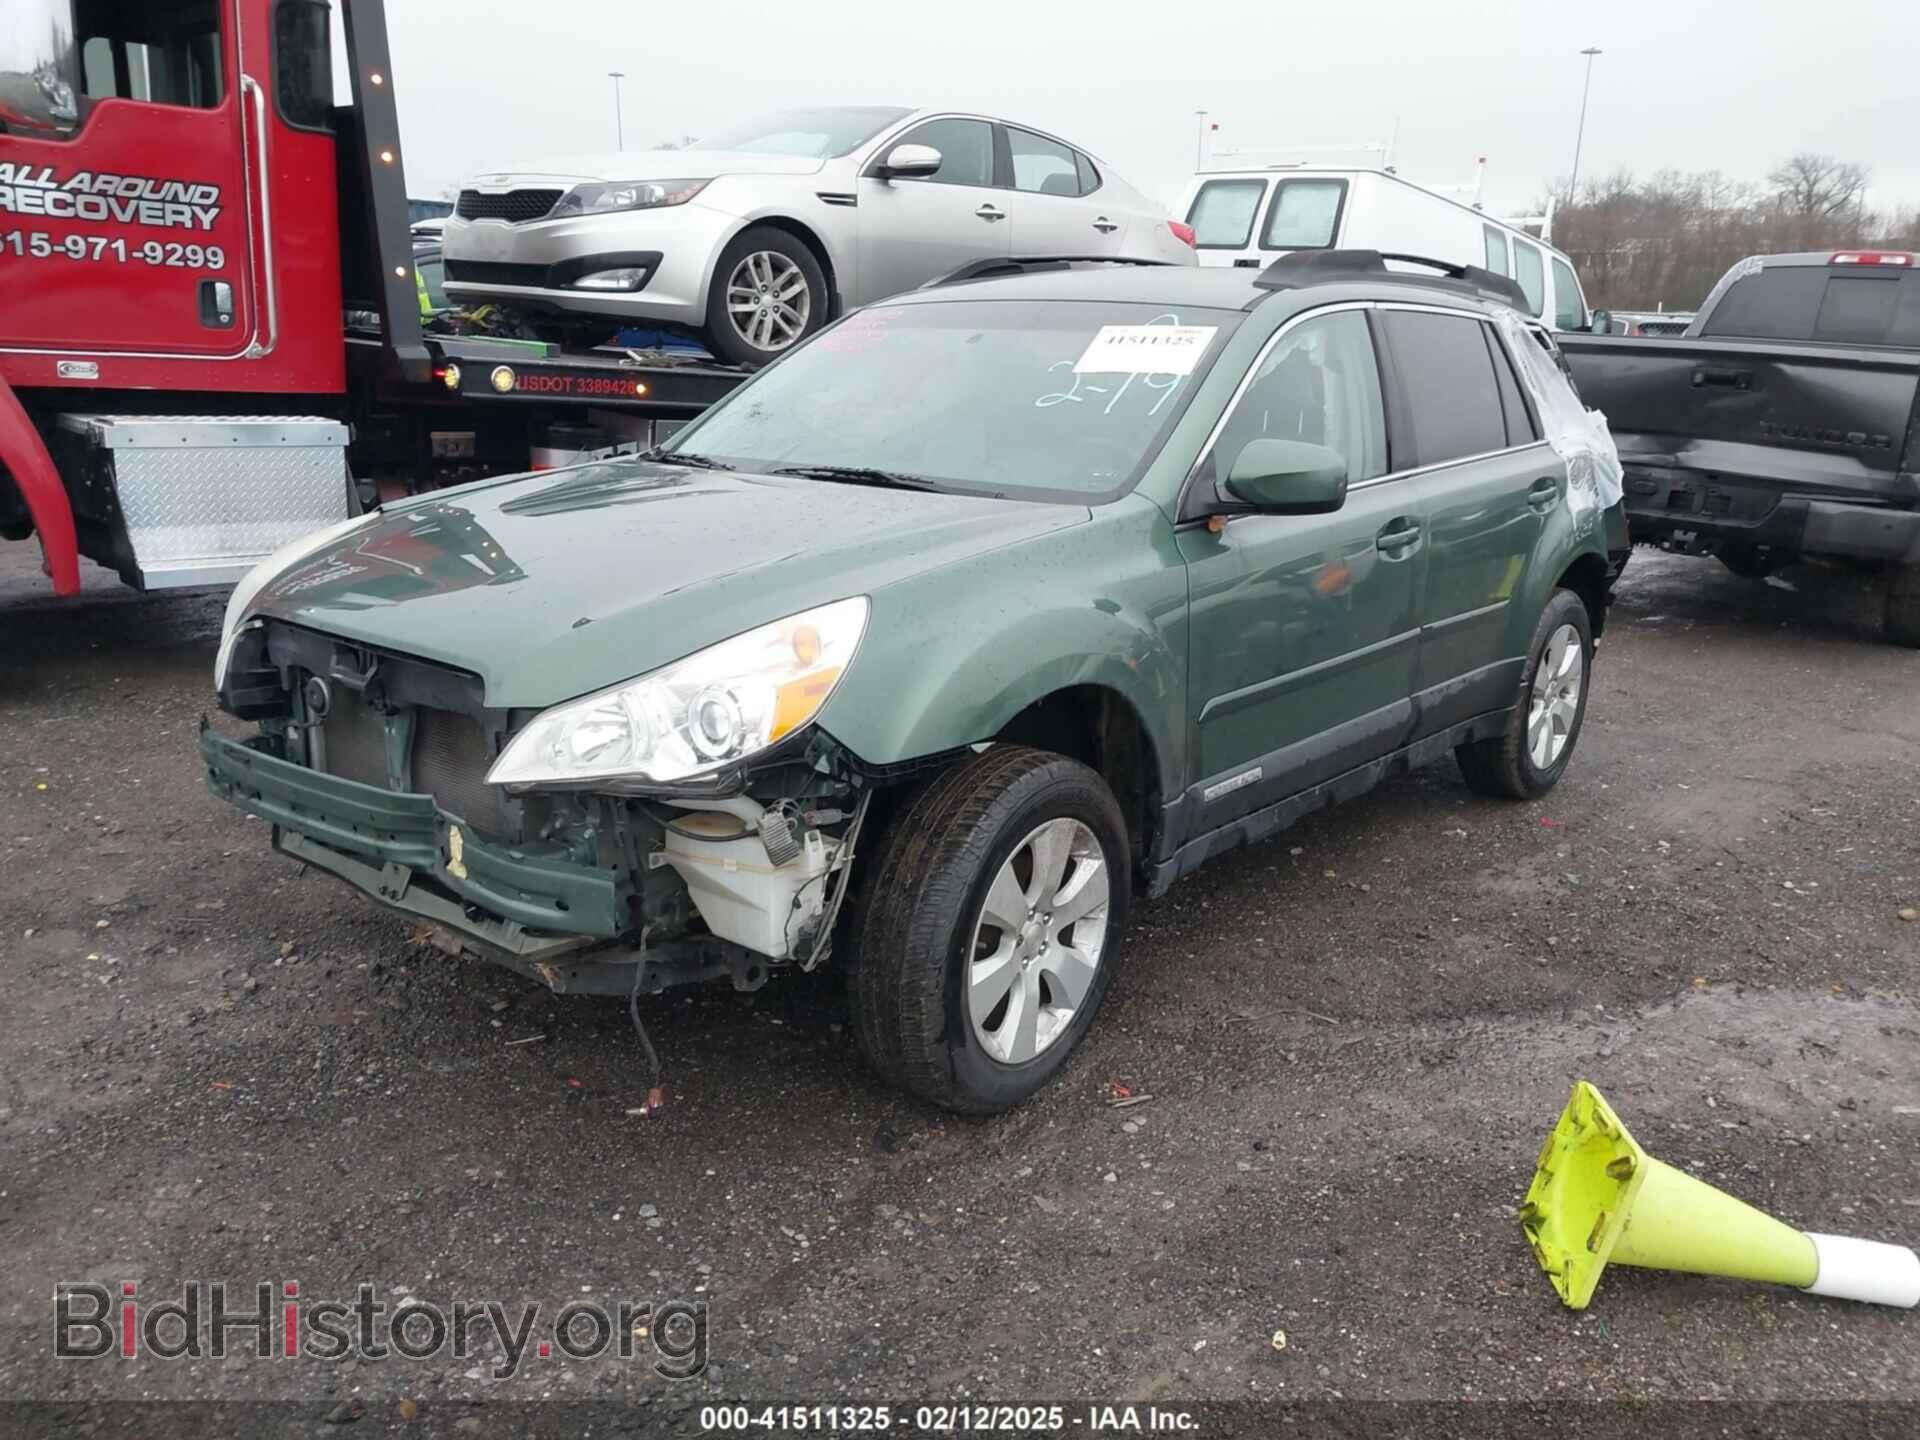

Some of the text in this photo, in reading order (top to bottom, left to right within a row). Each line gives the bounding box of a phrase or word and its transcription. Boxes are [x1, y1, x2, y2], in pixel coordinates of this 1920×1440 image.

[62, 172, 219, 205] AROUND
[0, 230, 225, 270] 15-971-9299
[515, 375, 573, 392] USDOT
